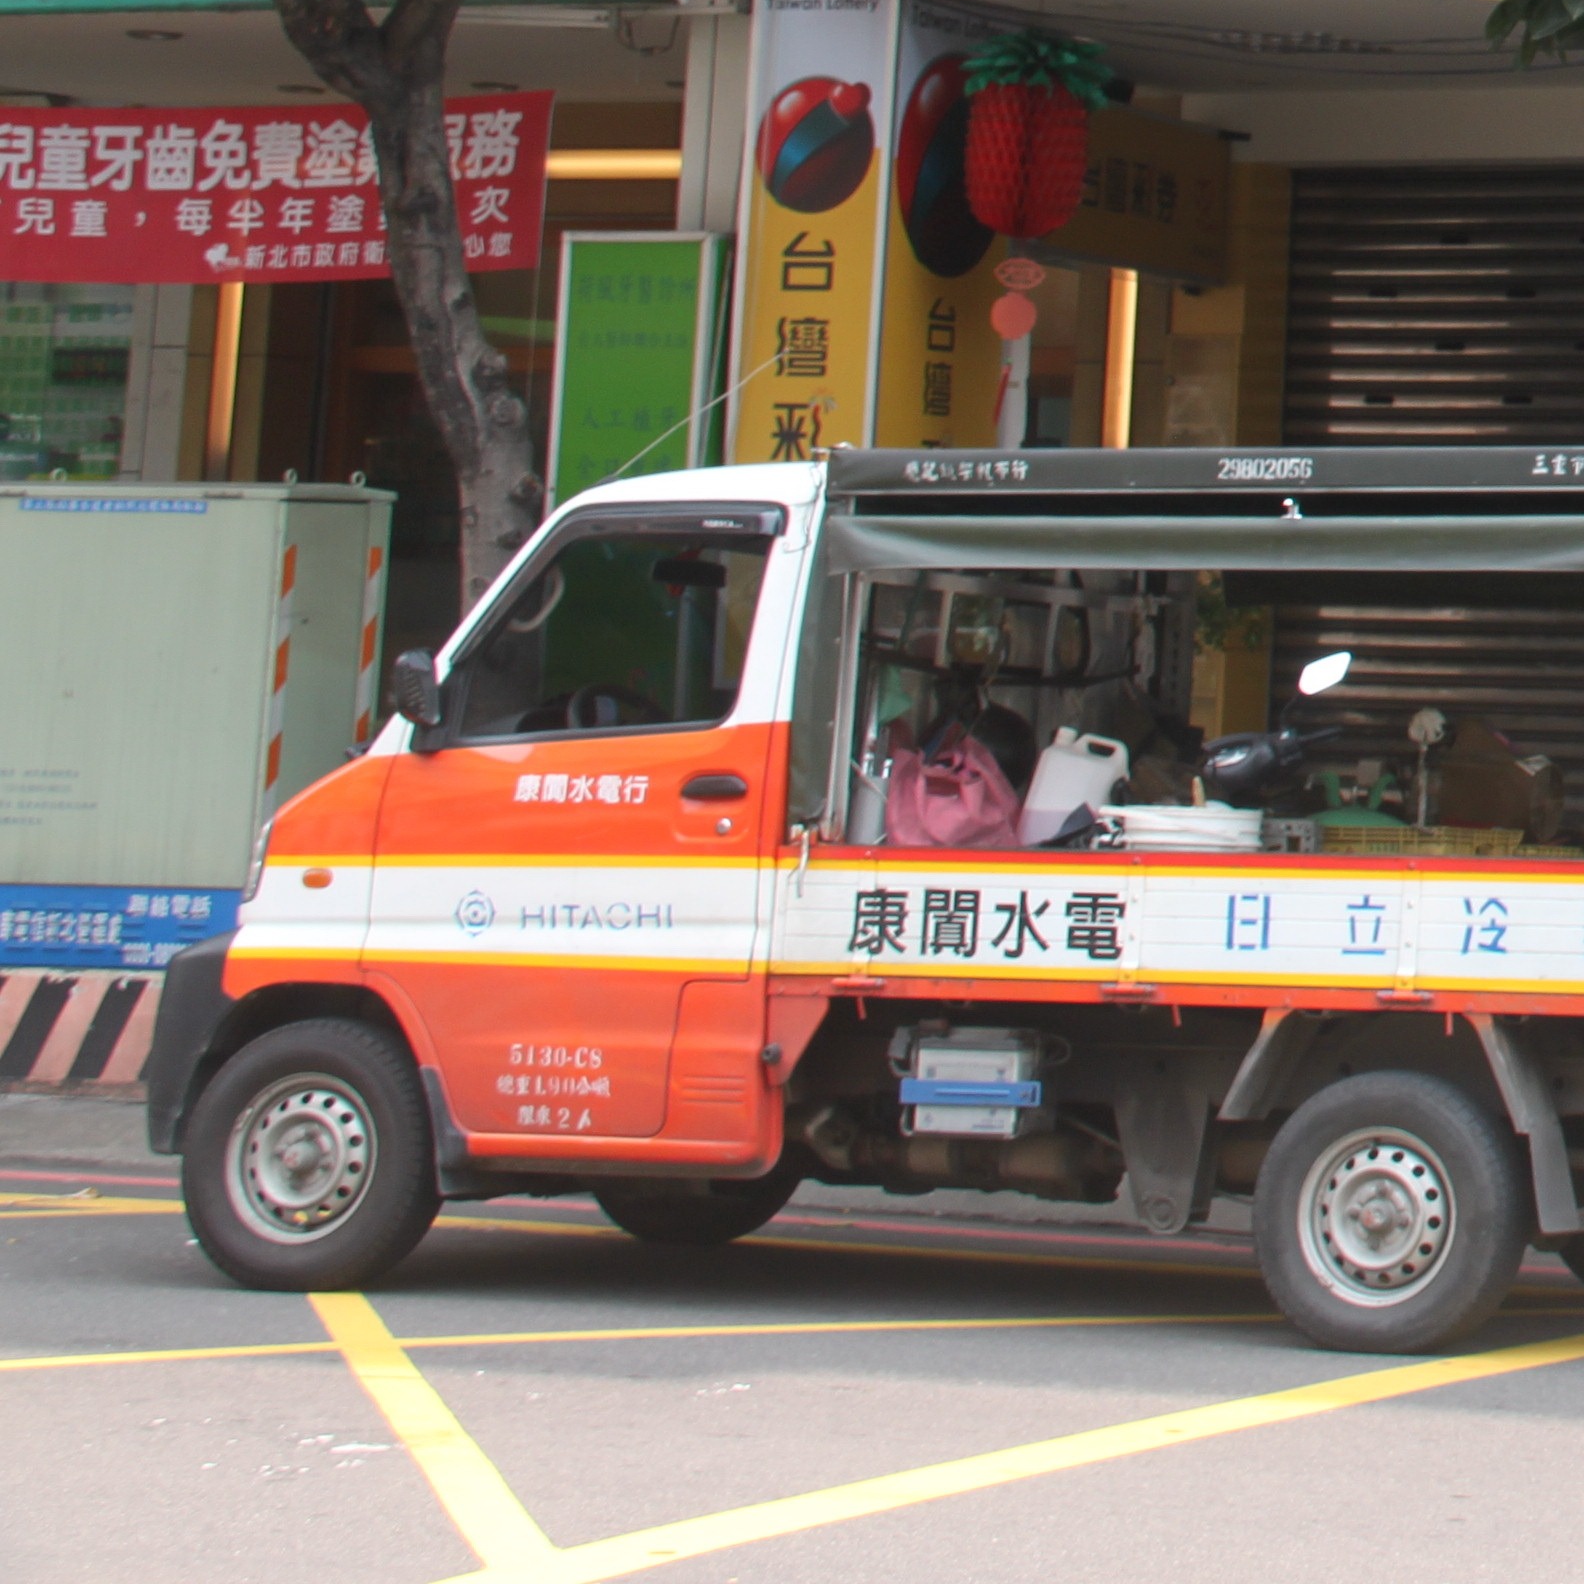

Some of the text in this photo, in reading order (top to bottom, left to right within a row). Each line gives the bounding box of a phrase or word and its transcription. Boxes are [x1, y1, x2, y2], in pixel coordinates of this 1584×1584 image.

[0, 108, 524, 192] 兒童牙齒免費塗務
[770, 230, 836, 462] 台灣彩
[1216, 456, 1315, 481] 29802056
[520, 901, 674, 930] HITACHI
[509, 1042, 603, 1068] 5130-C8
